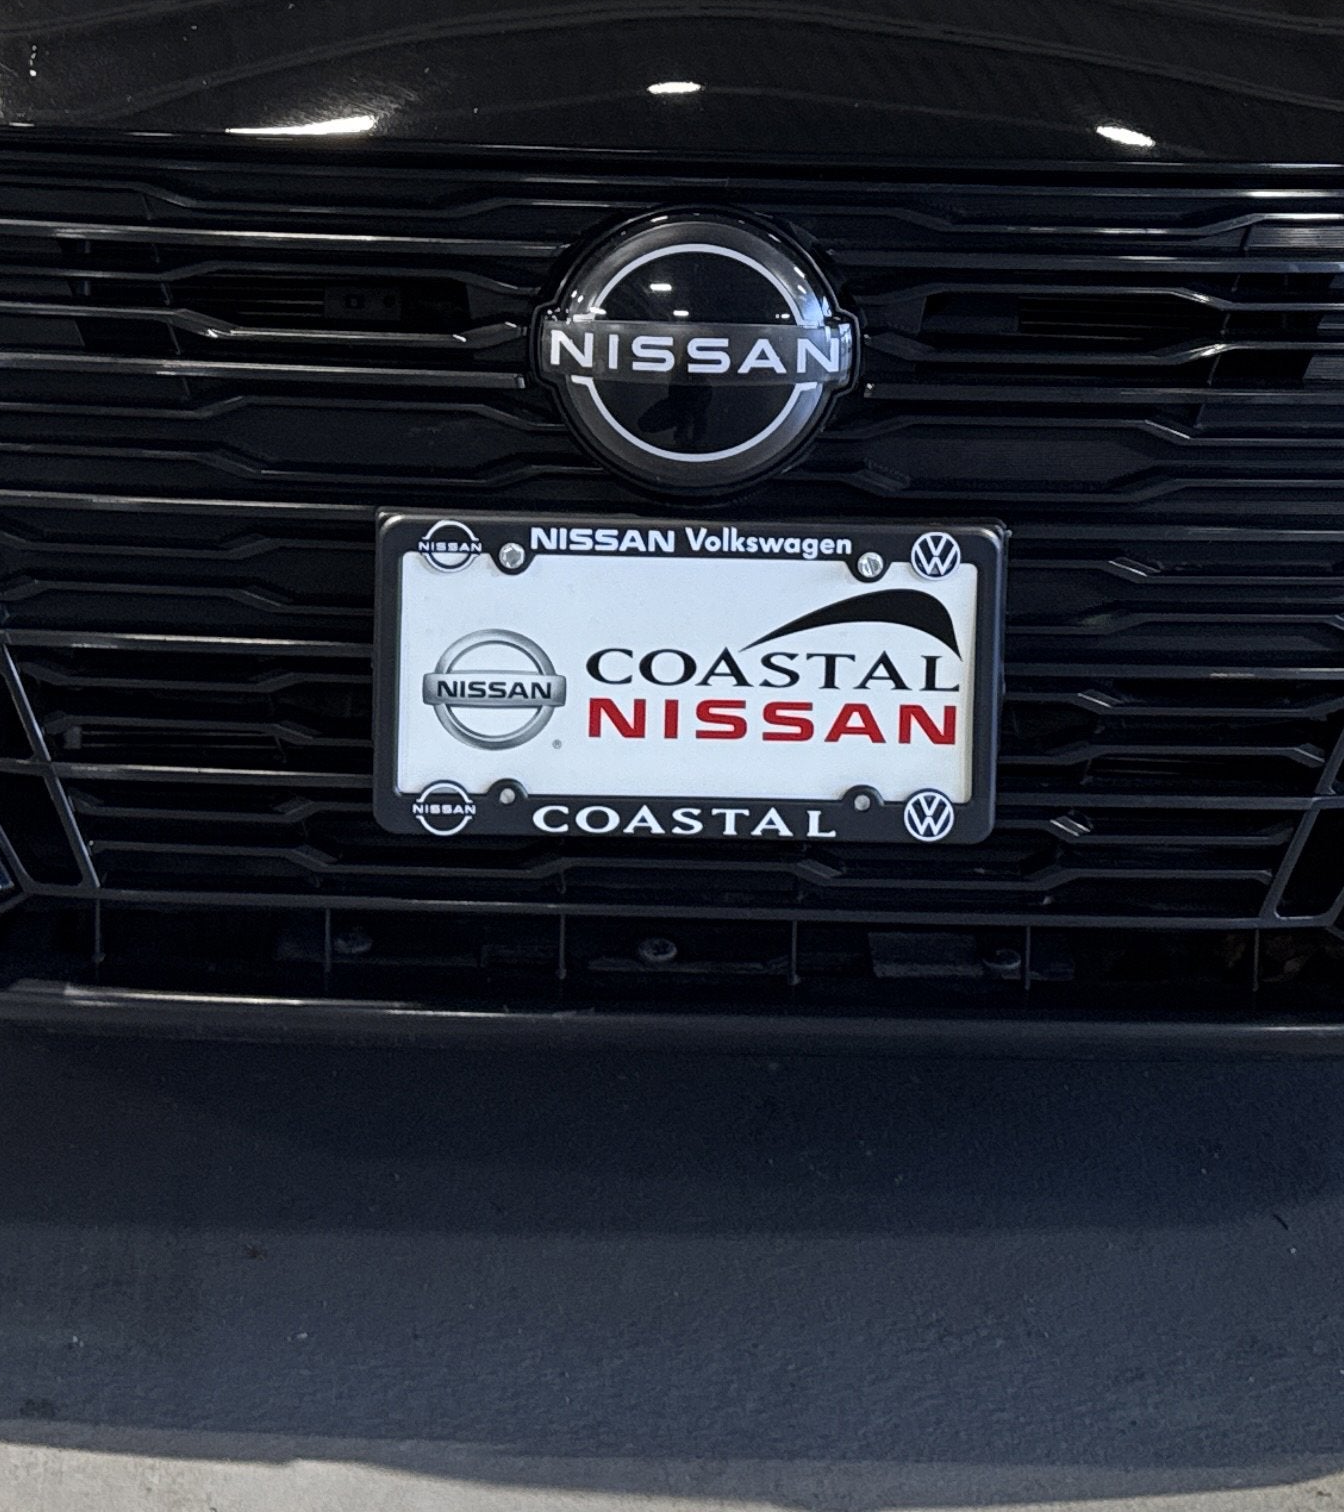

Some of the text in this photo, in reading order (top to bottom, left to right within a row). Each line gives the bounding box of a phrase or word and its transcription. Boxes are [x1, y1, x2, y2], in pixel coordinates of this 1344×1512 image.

[550, 329, 839, 374] NISSAN
[418, 541, 482, 552] NISSAN
[530, 526, 852, 559] NISSAN Volkswagen
[585, 646, 960, 692] COASTAL
[437, 680, 552, 699] NISSAN
[588, 697, 956, 745] NISSAN
[412, 803, 476, 815] NISSAN
[532, 805, 836, 838] COASTAL
